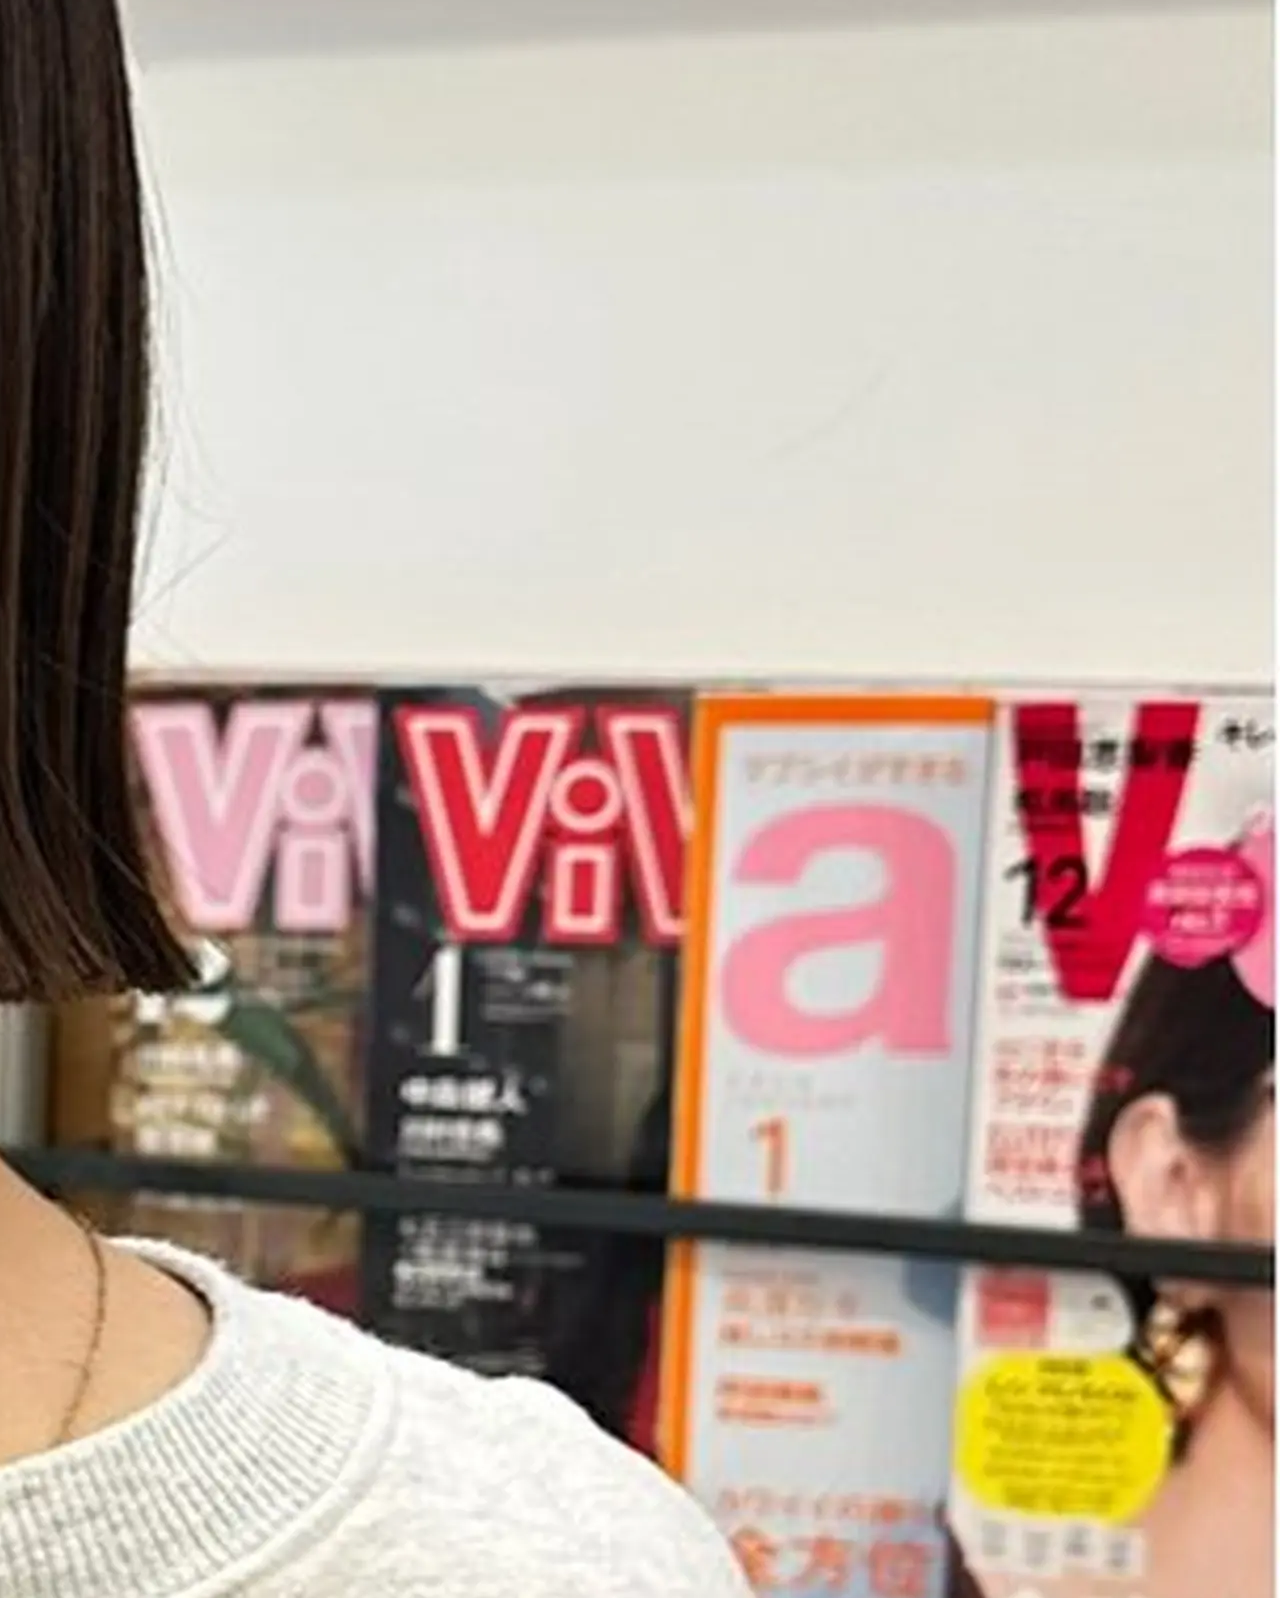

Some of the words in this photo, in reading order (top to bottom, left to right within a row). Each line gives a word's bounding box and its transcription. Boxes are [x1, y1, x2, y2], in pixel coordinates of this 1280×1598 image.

[721, 800, 959, 1062] a
[1005, 855, 1090, 930] 12
[751, 1117, 789, 1195] 1
